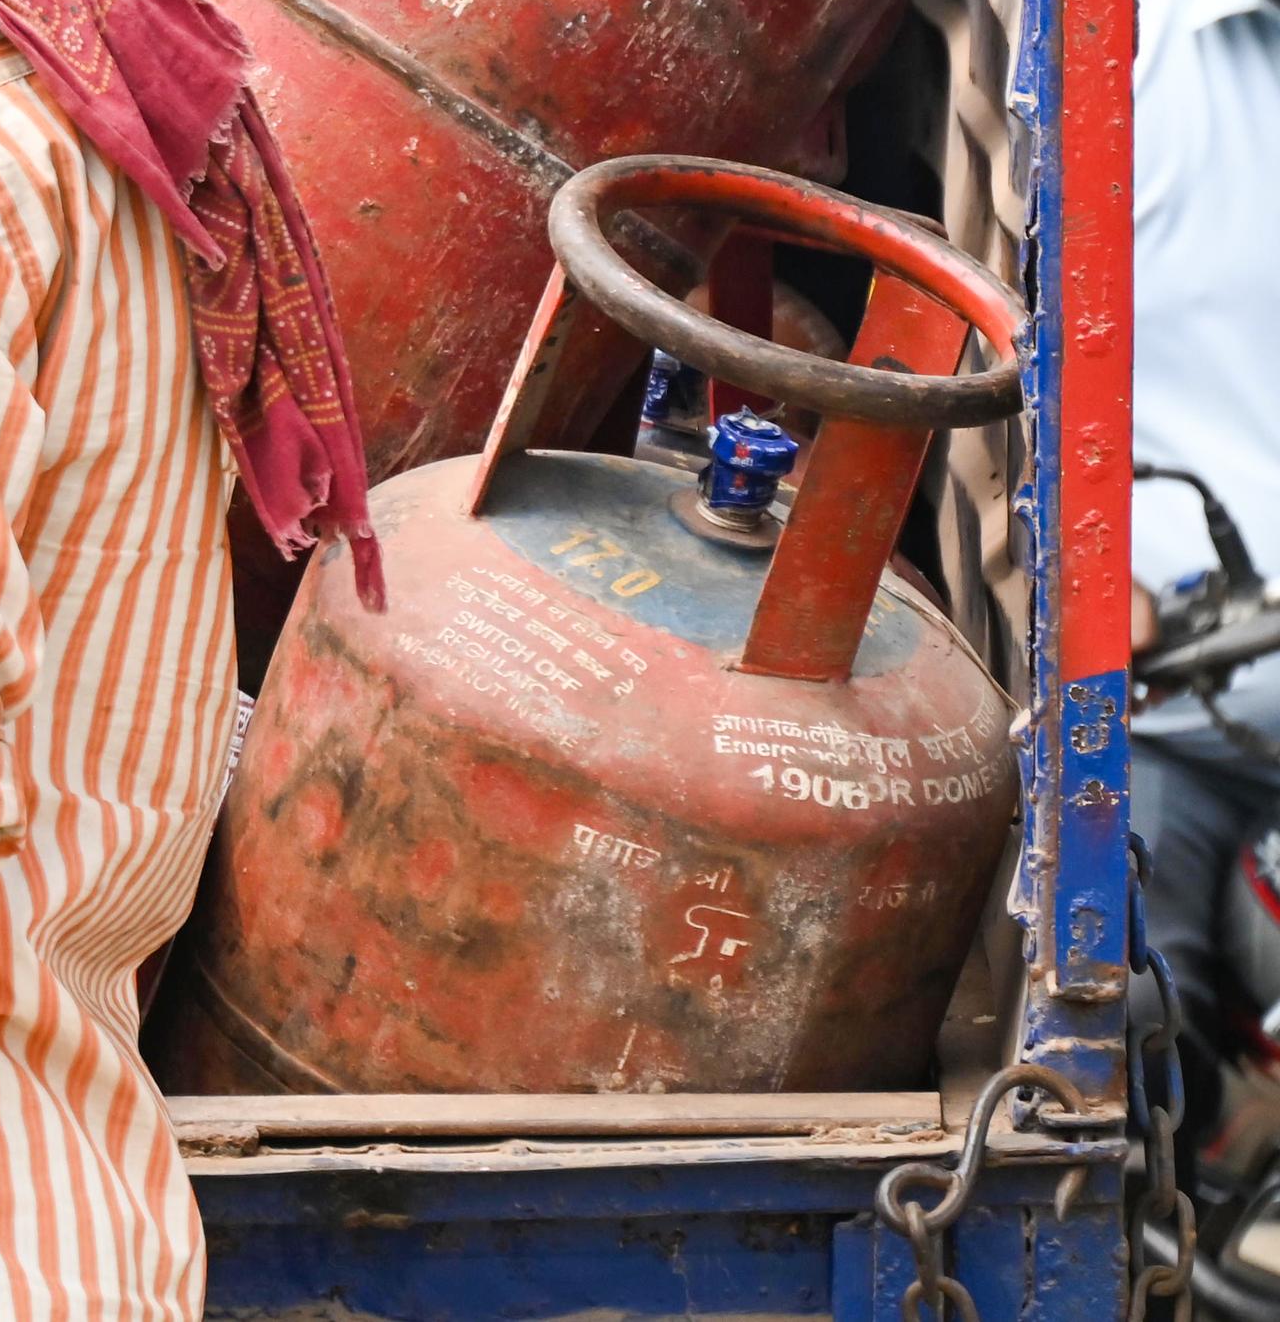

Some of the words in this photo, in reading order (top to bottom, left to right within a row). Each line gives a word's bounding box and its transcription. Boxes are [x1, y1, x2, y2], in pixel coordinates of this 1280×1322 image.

[548, 528, 664, 599] 17.0
[396, 632, 459, 672] WHEN
[456, 662, 508, 699] NOT
[453, 609, 538, 665] SWITCH
[534, 660, 584, 693] OFF
[619, 647, 649, 676] पर
[750, 763, 870, 811] 1906
